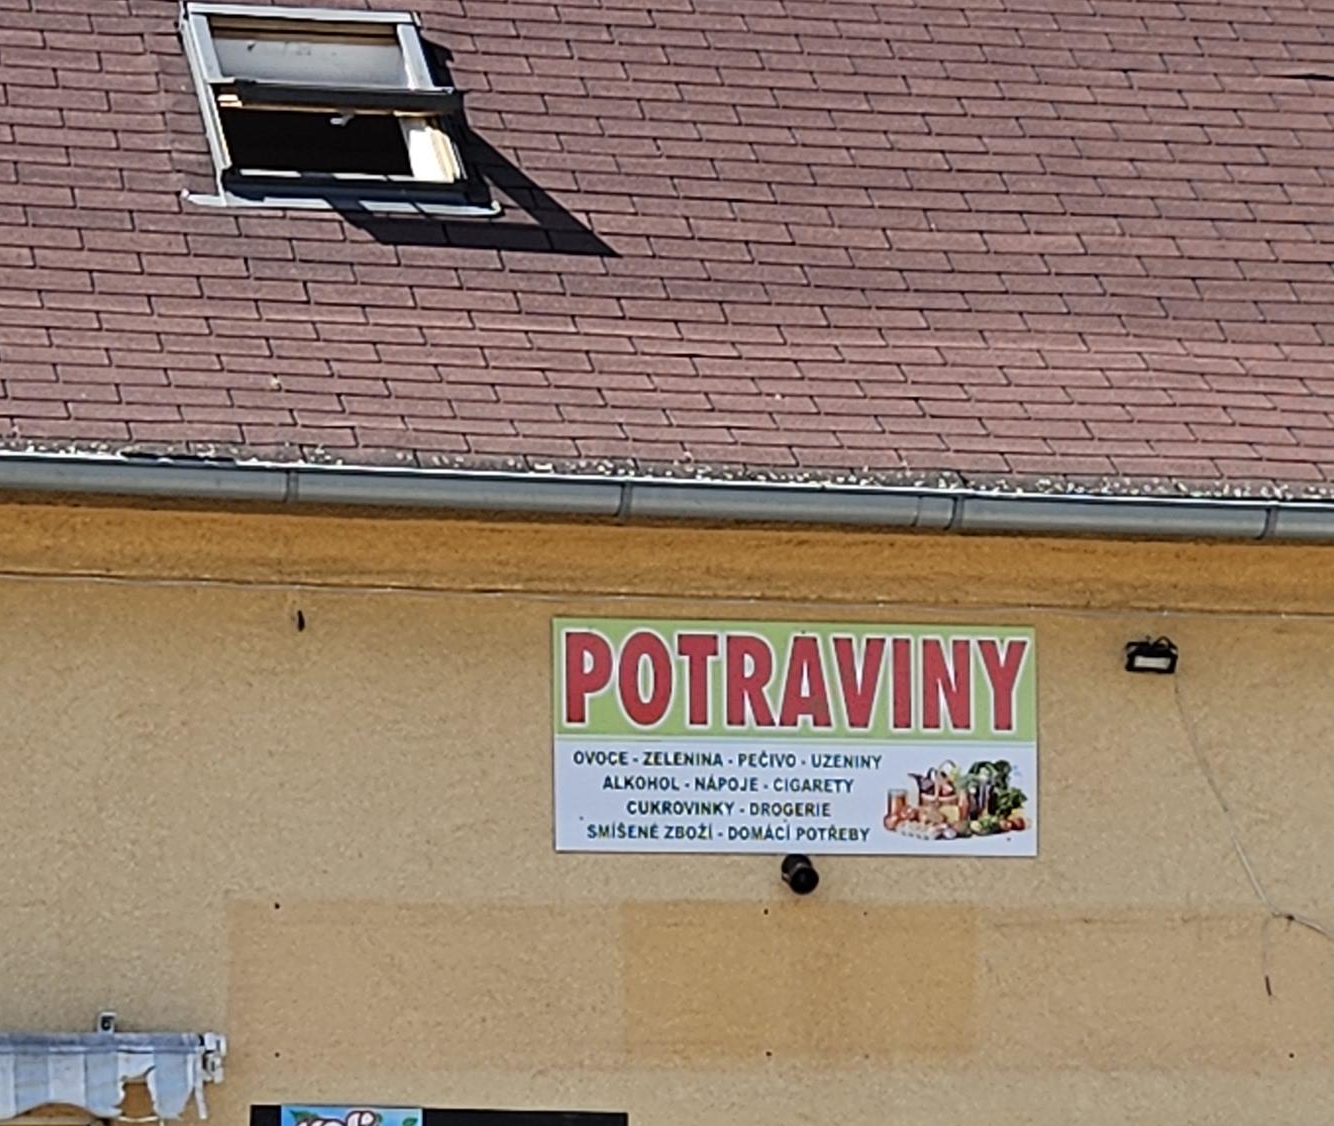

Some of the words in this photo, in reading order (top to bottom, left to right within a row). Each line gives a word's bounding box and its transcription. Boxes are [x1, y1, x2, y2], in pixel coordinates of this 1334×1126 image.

[564, 629, 1029, 731] POTRAVINY
[573, 750, 629, 766] OVOCE
[642, 751, 724, 767] ZELENINA
[737, 750, 797, 769] PEČIVO
[811, 754, 883, 769] UZENINY
[602, 775, 680, 791] ALKOHOL
[694, 774, 759, 793] NÁPOJE
[773, 777, 855, 794] CIGARETY
[626, 800, 735, 816] CUKROVINKY
[749, 802, 832, 818] DROGERIE
[586, 820, 660, 839] SMÍŠENÉ
[663, 821, 713, 840] ZBOŽÍ
[728, 823, 791, 841] DOMÁCÍ
[796, 824, 871, 842] POTŘEBY
